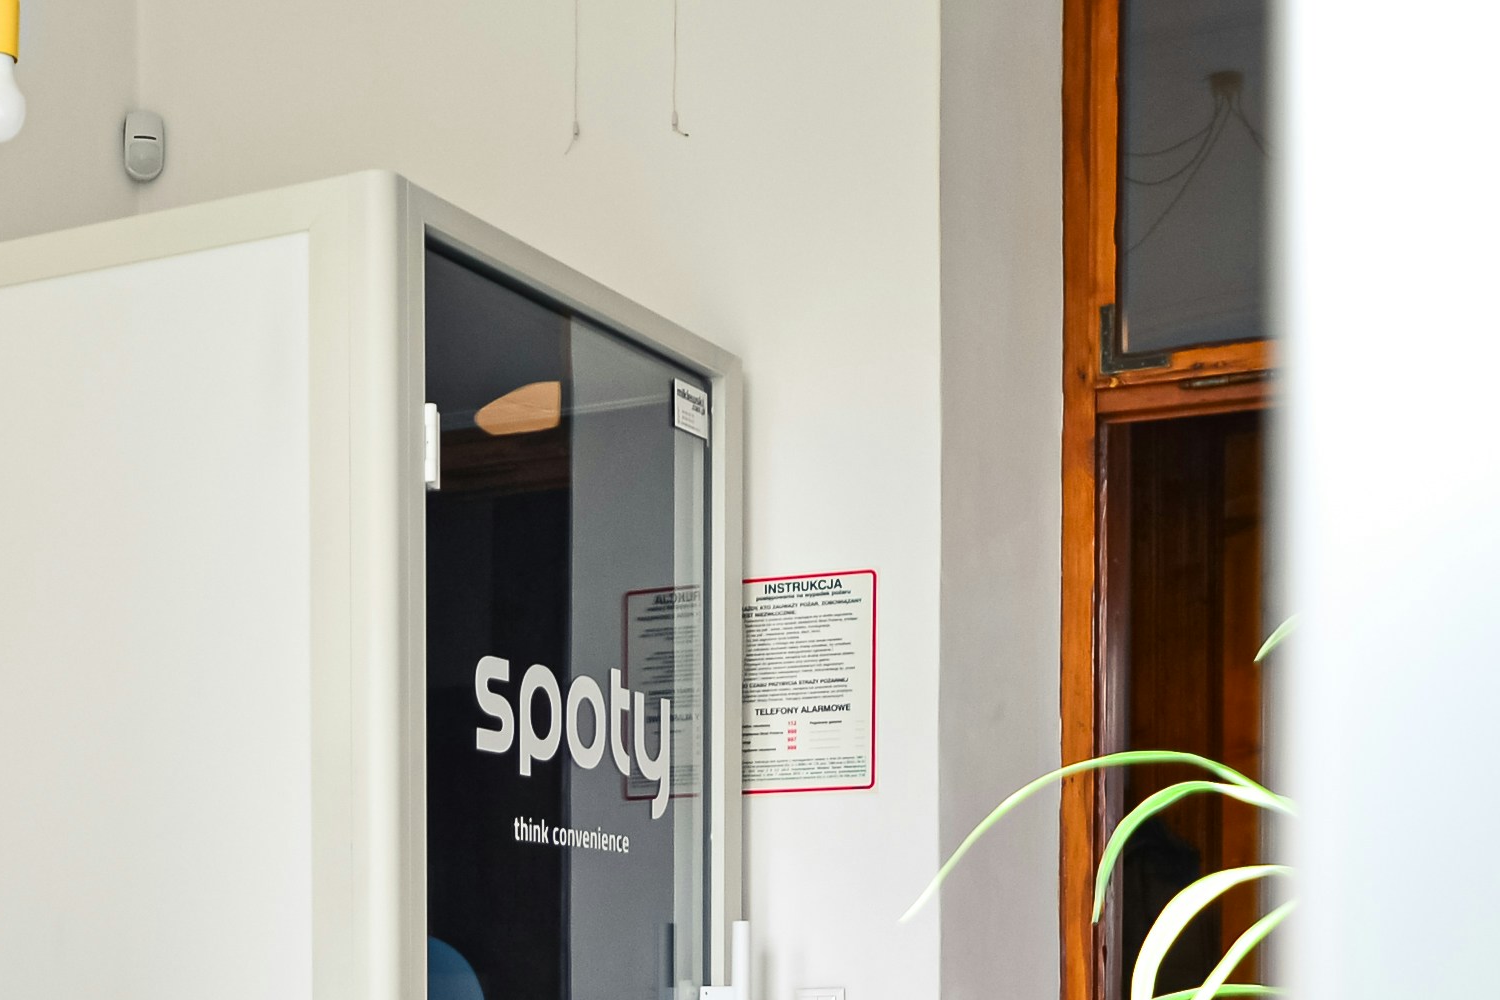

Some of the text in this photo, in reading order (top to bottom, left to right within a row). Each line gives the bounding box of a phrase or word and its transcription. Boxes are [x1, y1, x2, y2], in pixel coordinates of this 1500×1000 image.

[764, 578, 843, 595] INSTRUKCJA
[755, 703, 851, 717] TELEFONY ALARMOWE
[475, 655, 671, 820] spoty
[514, 816, 629, 853] think convenience
